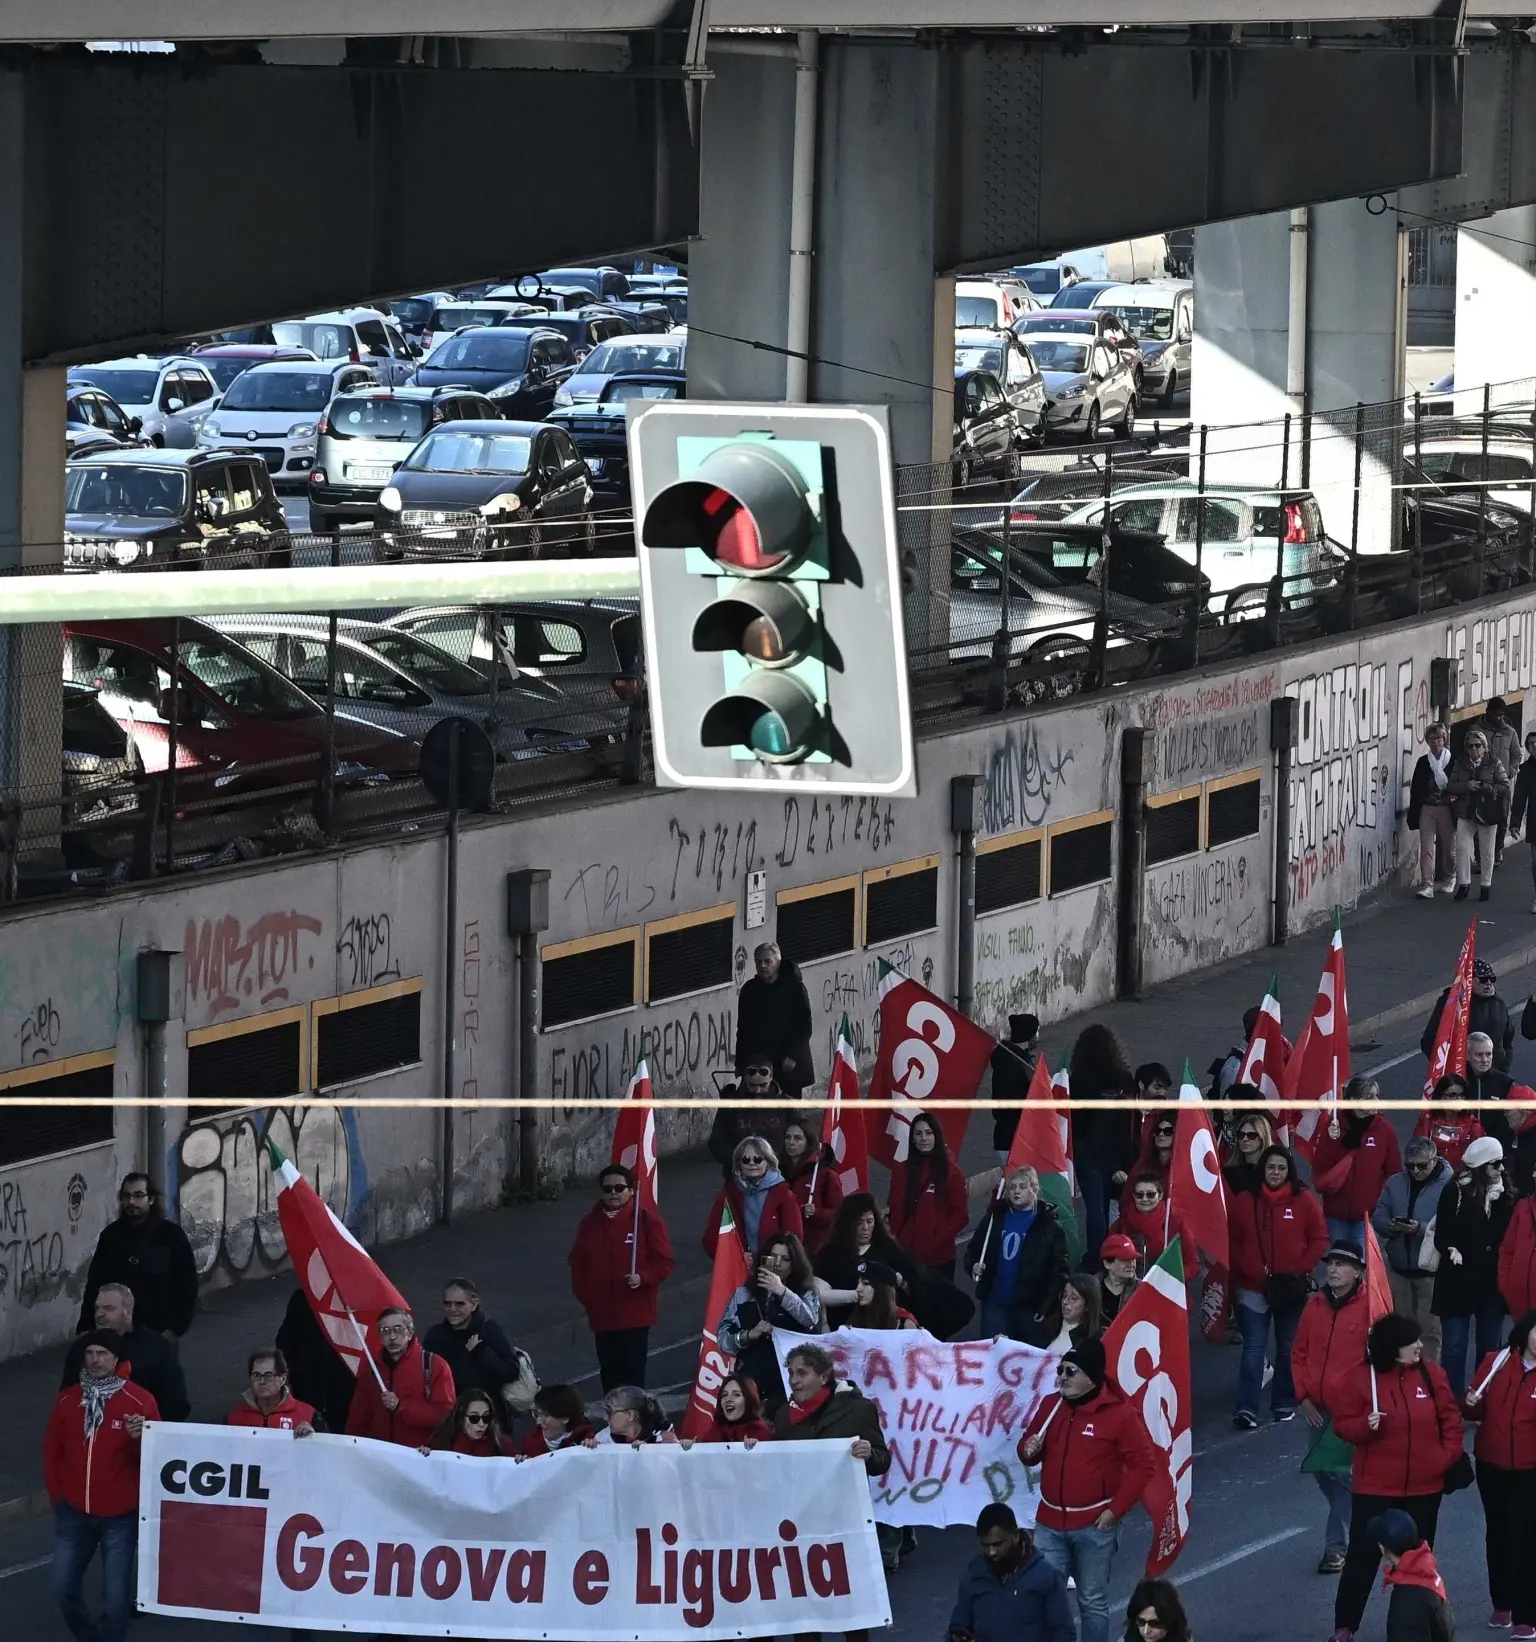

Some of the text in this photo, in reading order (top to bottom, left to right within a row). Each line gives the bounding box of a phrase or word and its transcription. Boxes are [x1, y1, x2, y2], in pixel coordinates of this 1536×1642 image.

[160, 1459, 270, 1500] CGIL
[276, 1512, 851, 1629] Genova e Liguria
